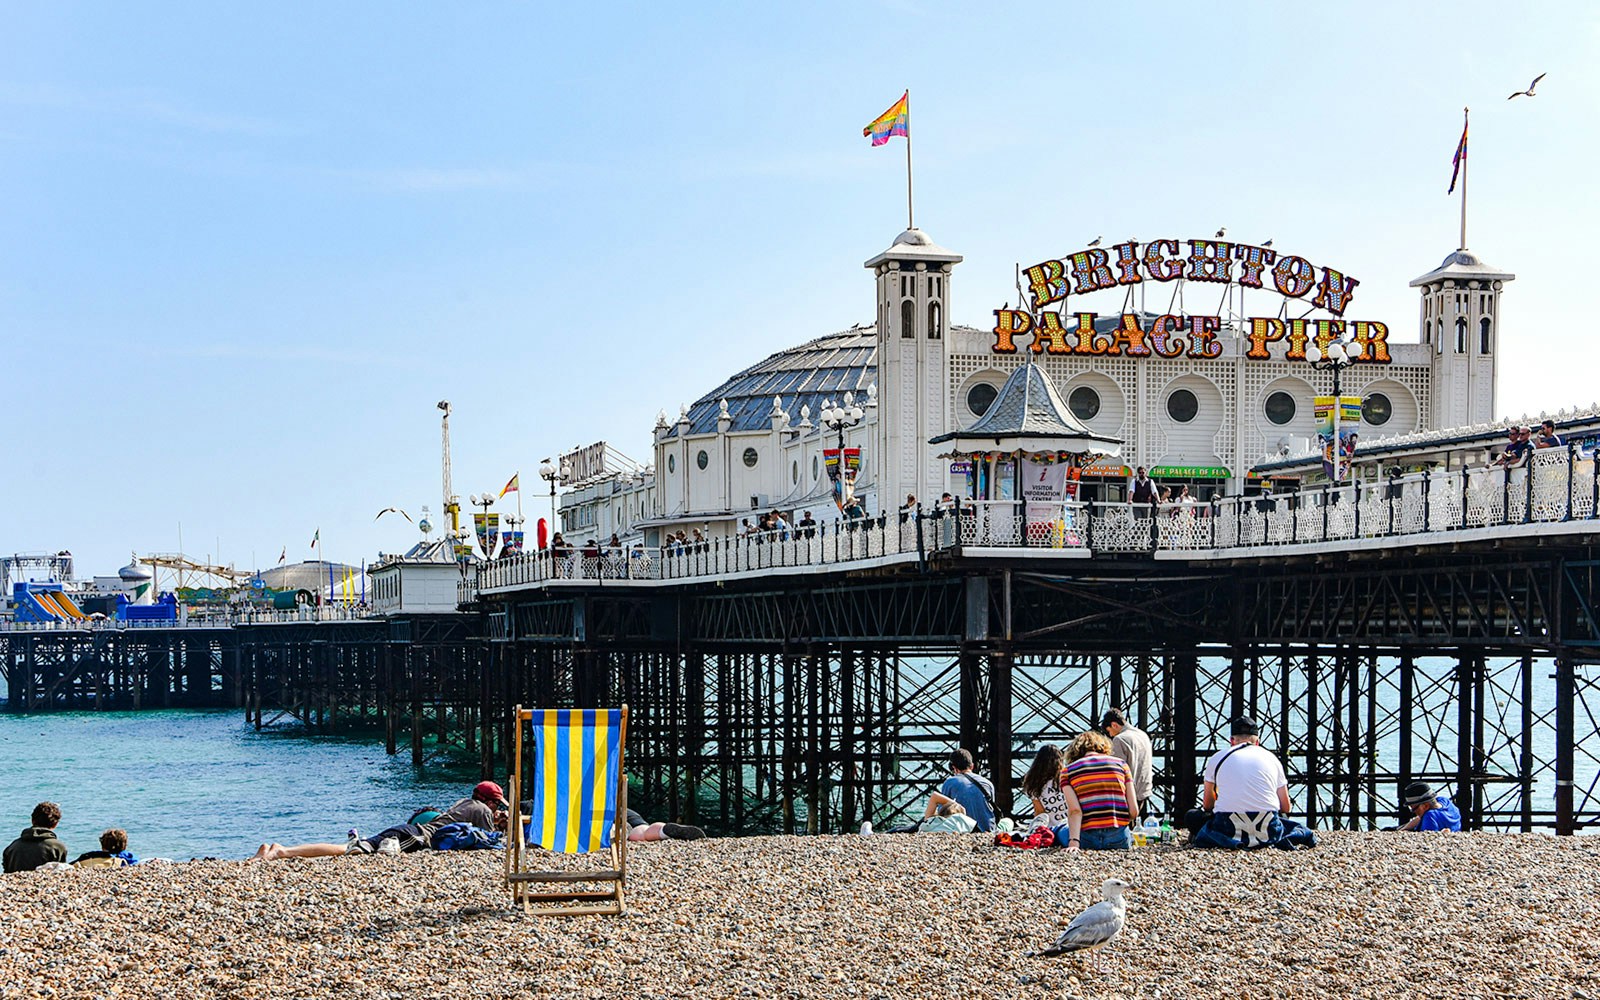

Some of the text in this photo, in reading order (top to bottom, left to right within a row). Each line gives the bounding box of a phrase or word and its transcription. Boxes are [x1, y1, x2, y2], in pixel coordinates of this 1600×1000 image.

[1022, 239, 1360, 316] BRIGHTON
[993, 309, 1392, 364] PALACE PIER
[1229, 811, 1274, 847] NY
